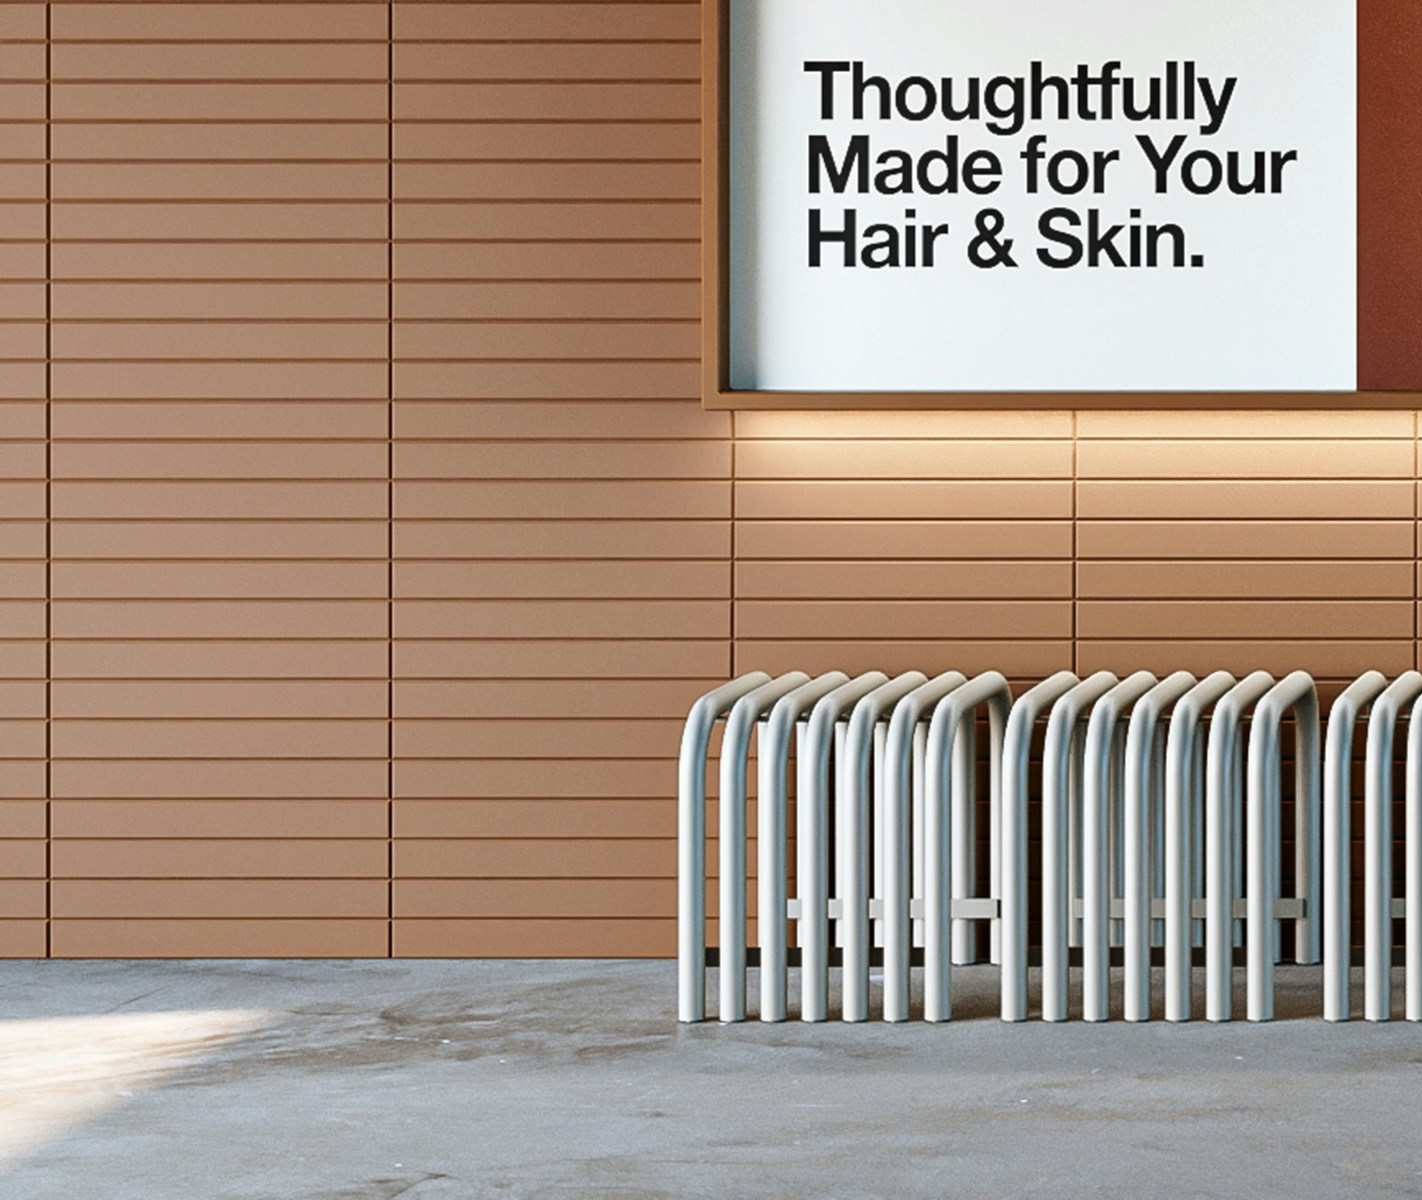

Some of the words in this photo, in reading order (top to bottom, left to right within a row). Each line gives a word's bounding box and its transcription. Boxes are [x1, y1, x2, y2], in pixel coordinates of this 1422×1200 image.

[803, 61, 1238, 136] Thoughtfully
[808, 134, 1003, 195] Made
[1019, 134, 1120, 195] for
[1135, 134, 1298, 195] Your
[808, 208, 949, 269] Hair
[967, 207, 1019, 269] &
[1036, 207, 1204, 269] Skin.
